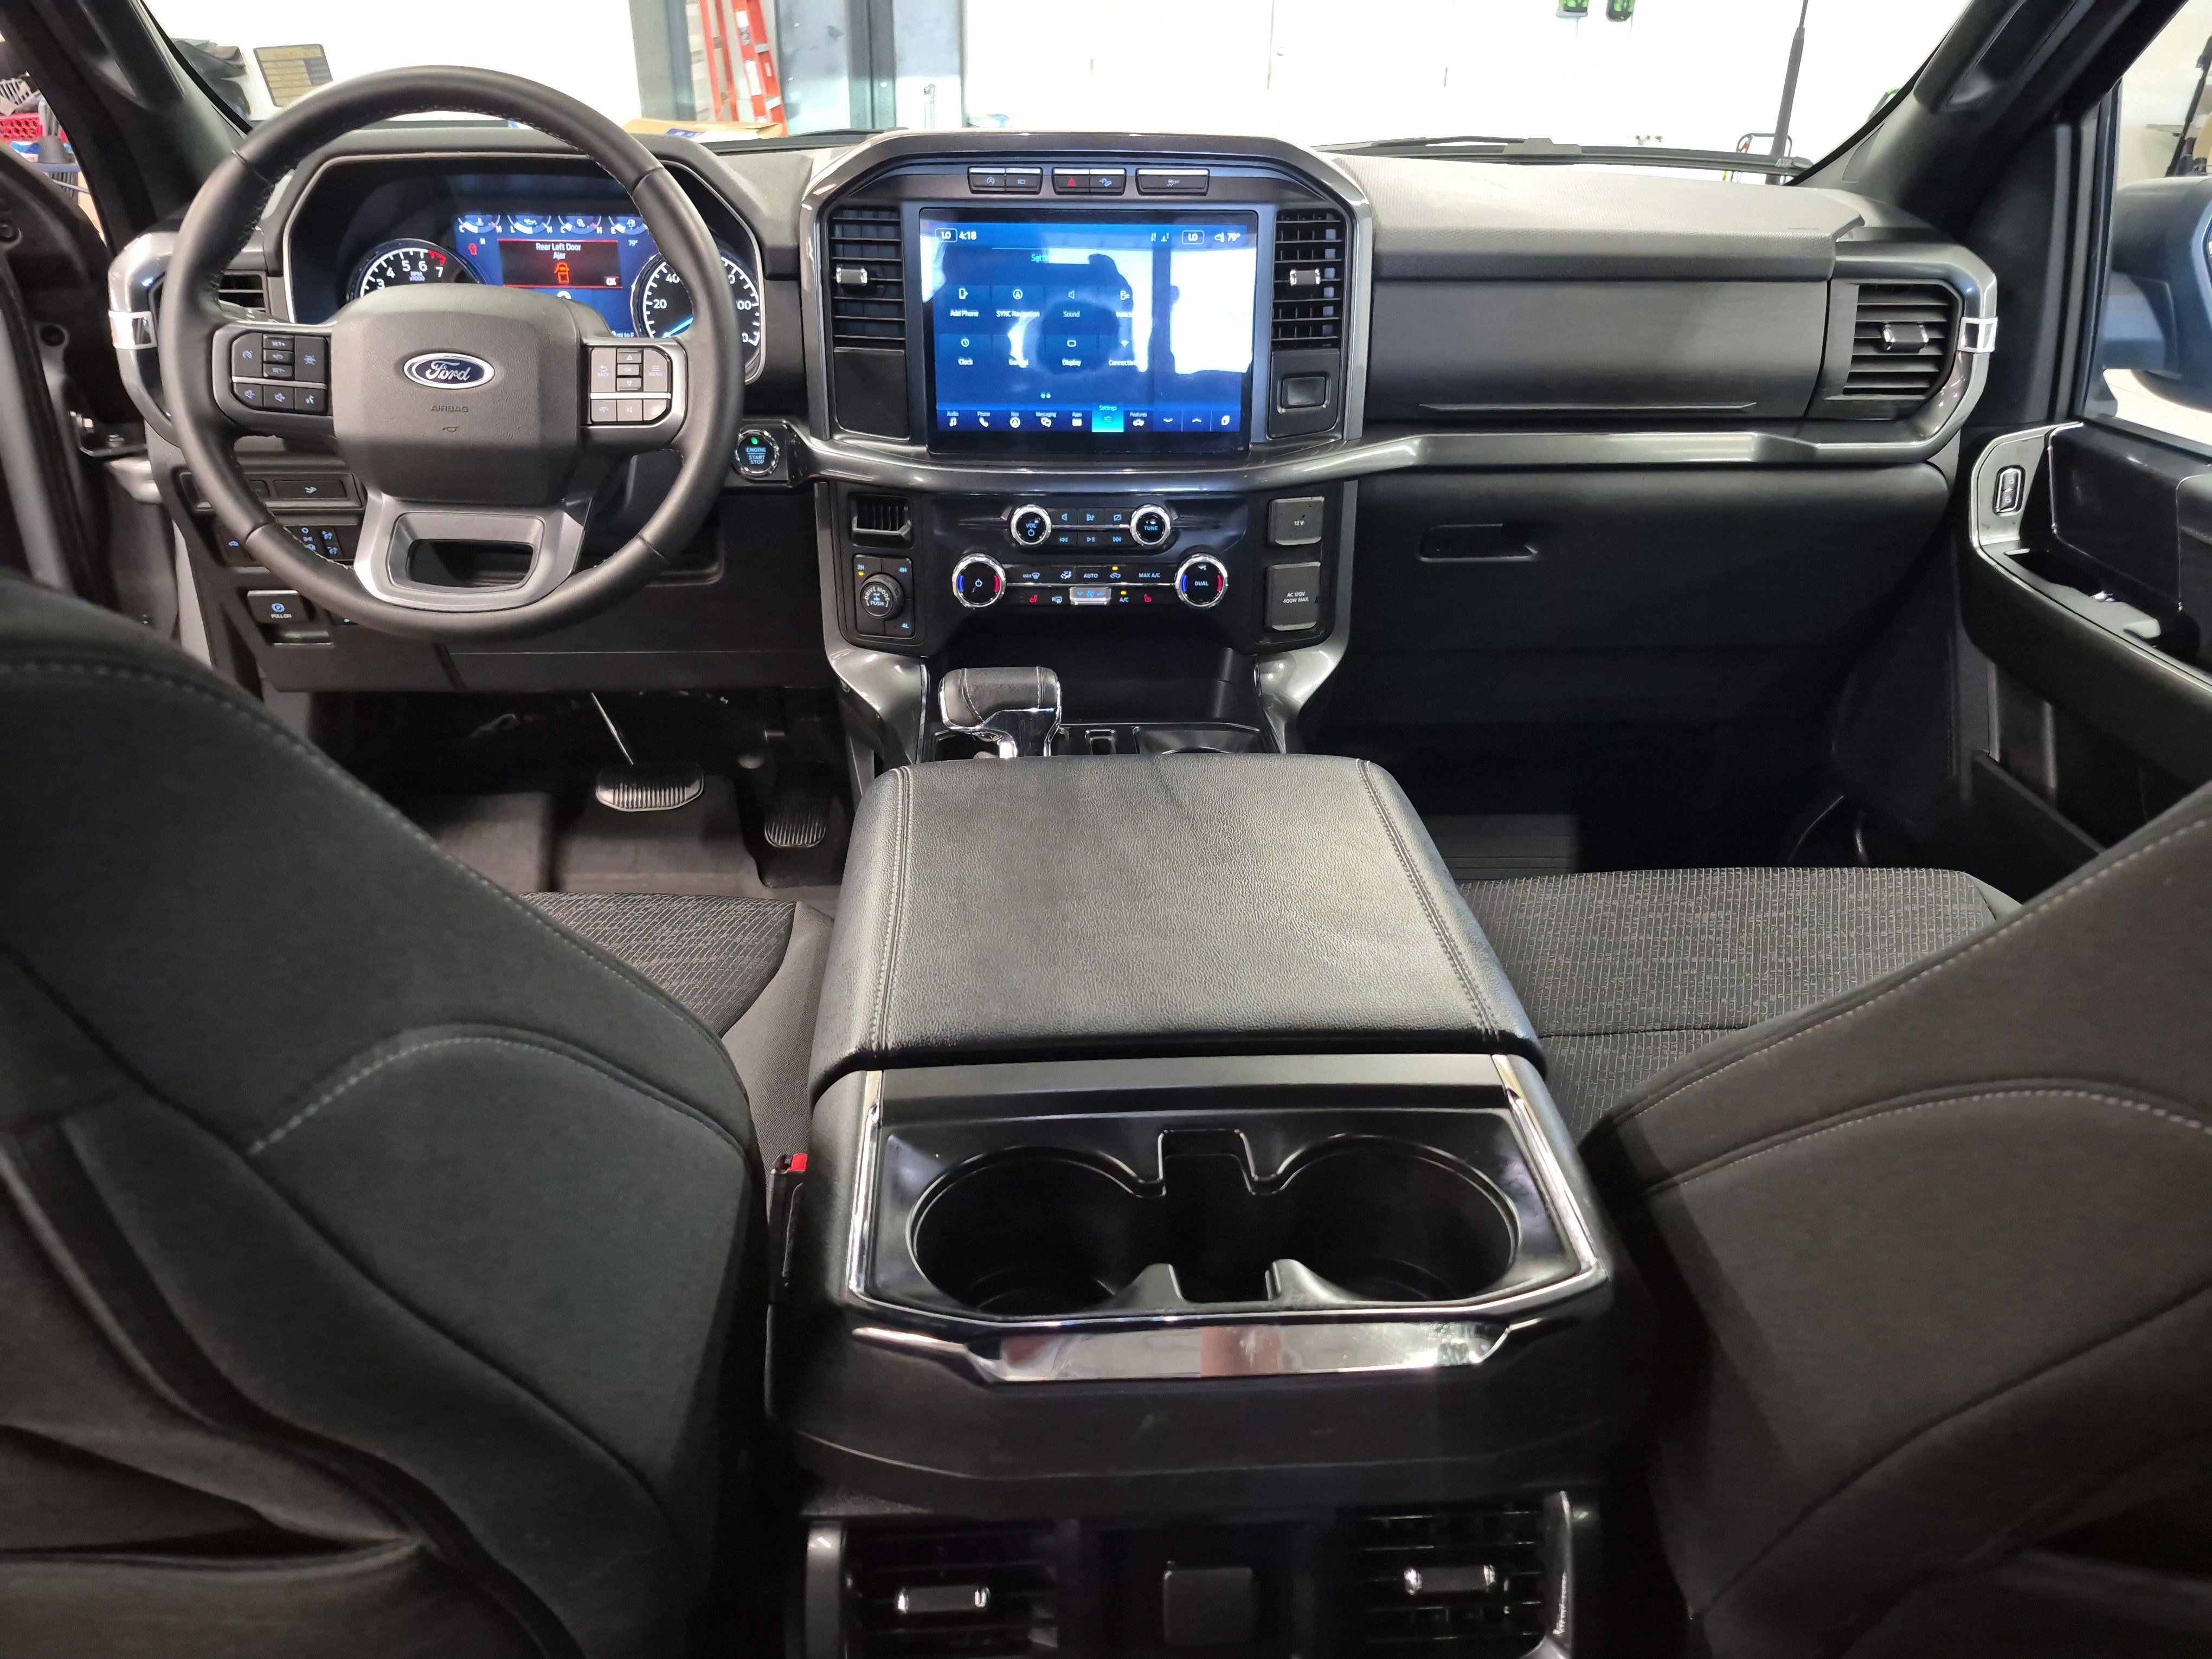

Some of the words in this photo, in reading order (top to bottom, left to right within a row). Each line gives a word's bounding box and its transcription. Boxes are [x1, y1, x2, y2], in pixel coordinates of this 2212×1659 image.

[536, 242, 551, 250] Rear
[551, 242, 565, 250] Left
[402, 260, 410, 272] 5
[419, 260, 427, 272] 6
[386, 267, 395, 278] 4
[435, 266, 443, 278] 7
[665, 273, 680, 283] 40
[376, 279, 385, 290] 3
[653, 299, 667, 309] 20
[425, 360, 471, 381] Ford
[864, 587, 877, 600] DRIVE
[877, 587, 890, 601] MODE
